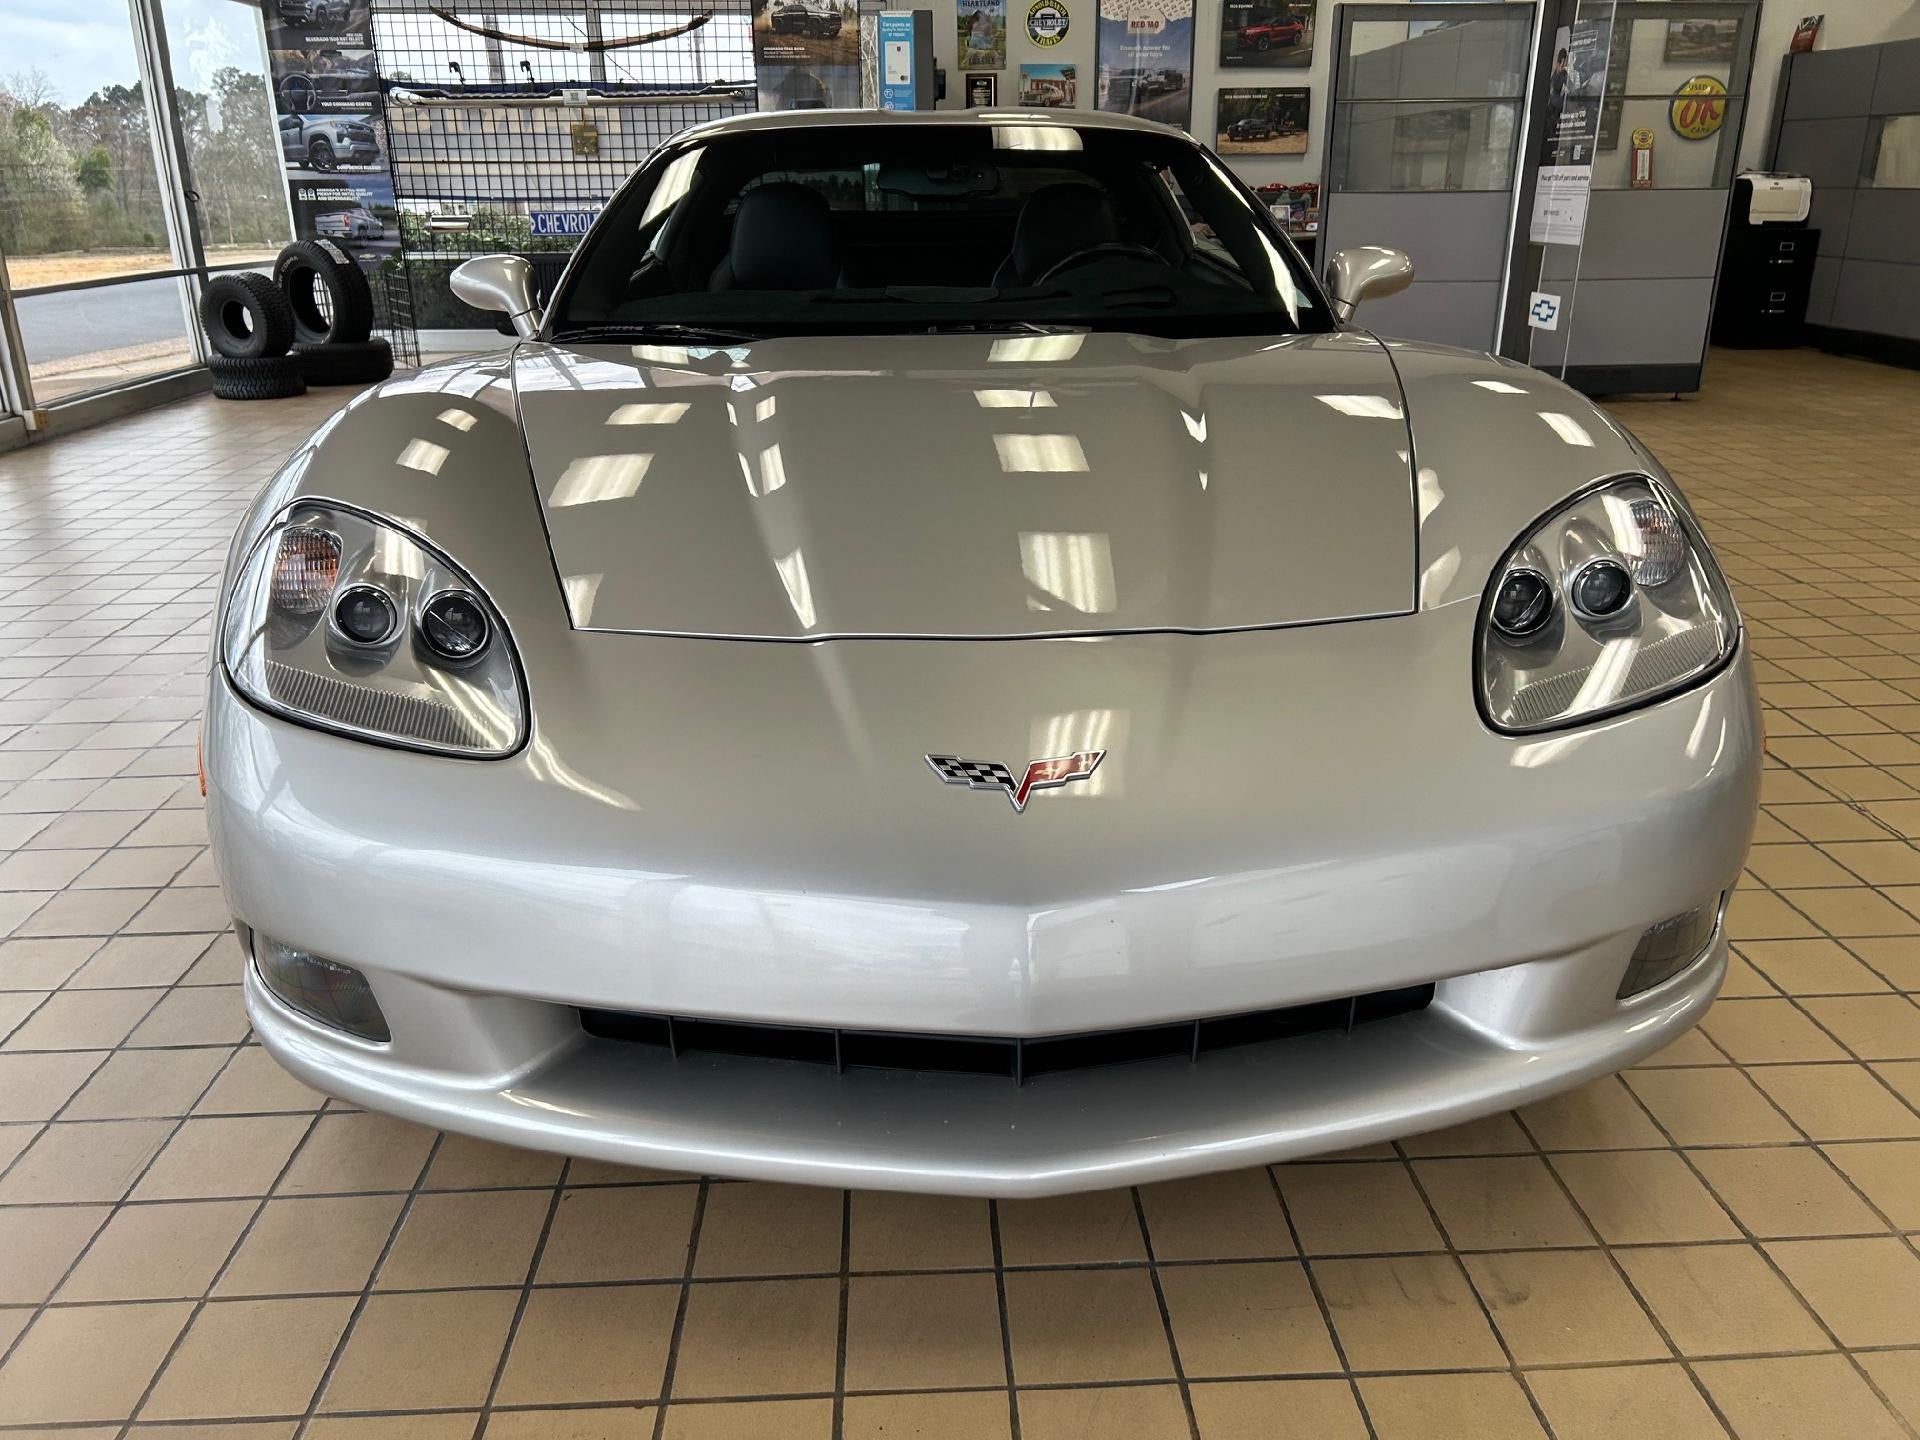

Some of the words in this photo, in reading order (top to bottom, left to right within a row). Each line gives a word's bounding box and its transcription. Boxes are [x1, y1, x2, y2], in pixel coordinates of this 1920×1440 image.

[1030, 18, 1066, 26] CHEVROLET
[1680, 86, 1720, 128] OK
[538, 213, 599, 233] CHEVROL
